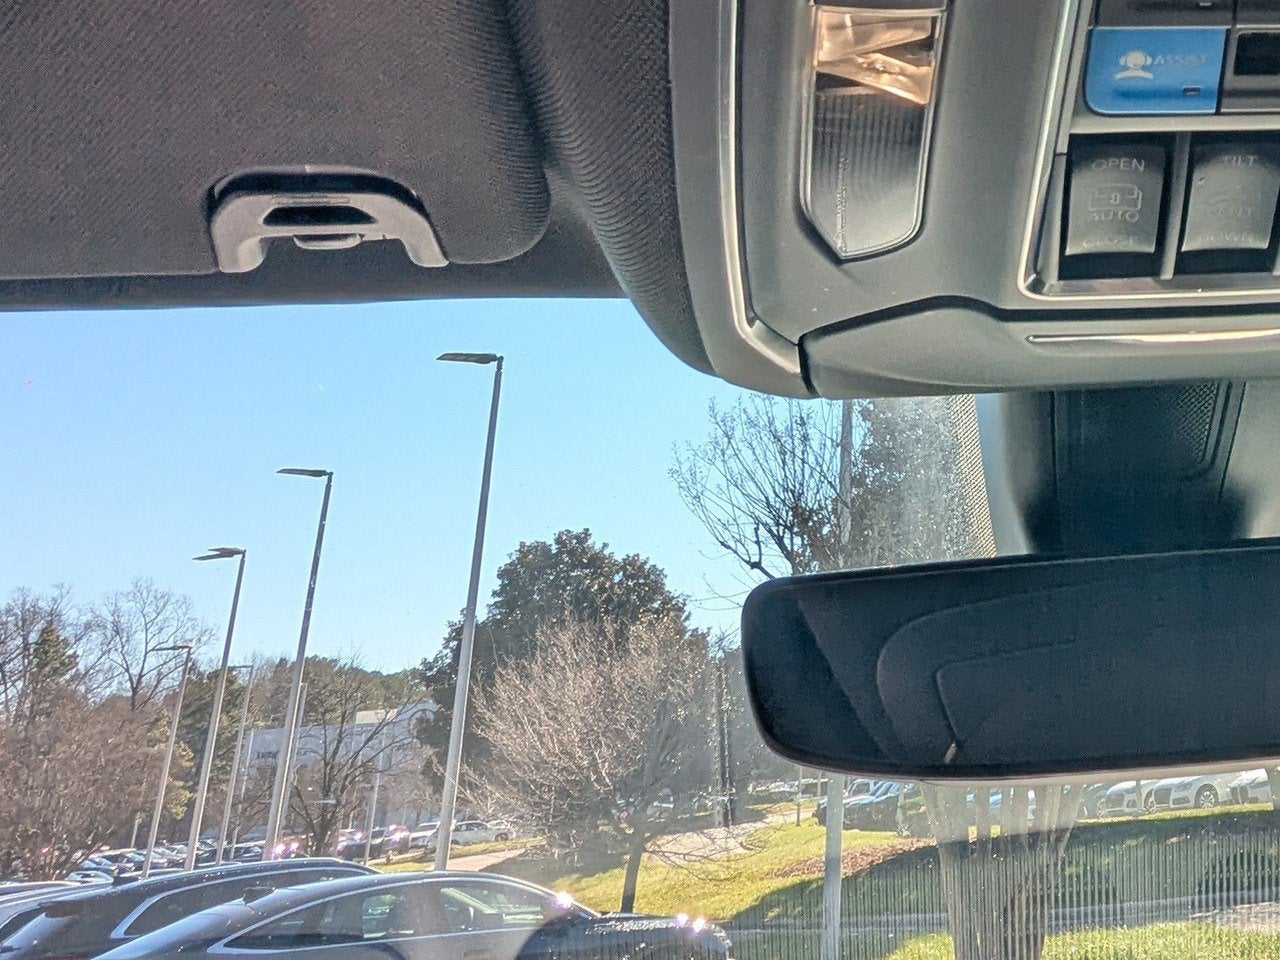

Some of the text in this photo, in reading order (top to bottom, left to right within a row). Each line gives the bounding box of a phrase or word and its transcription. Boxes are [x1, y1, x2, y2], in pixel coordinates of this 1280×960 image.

[1092, 157, 1146, 172] OPEN
[1222, 154, 1258, 167] TILT
[1088, 209, 1139, 223] AUTO
